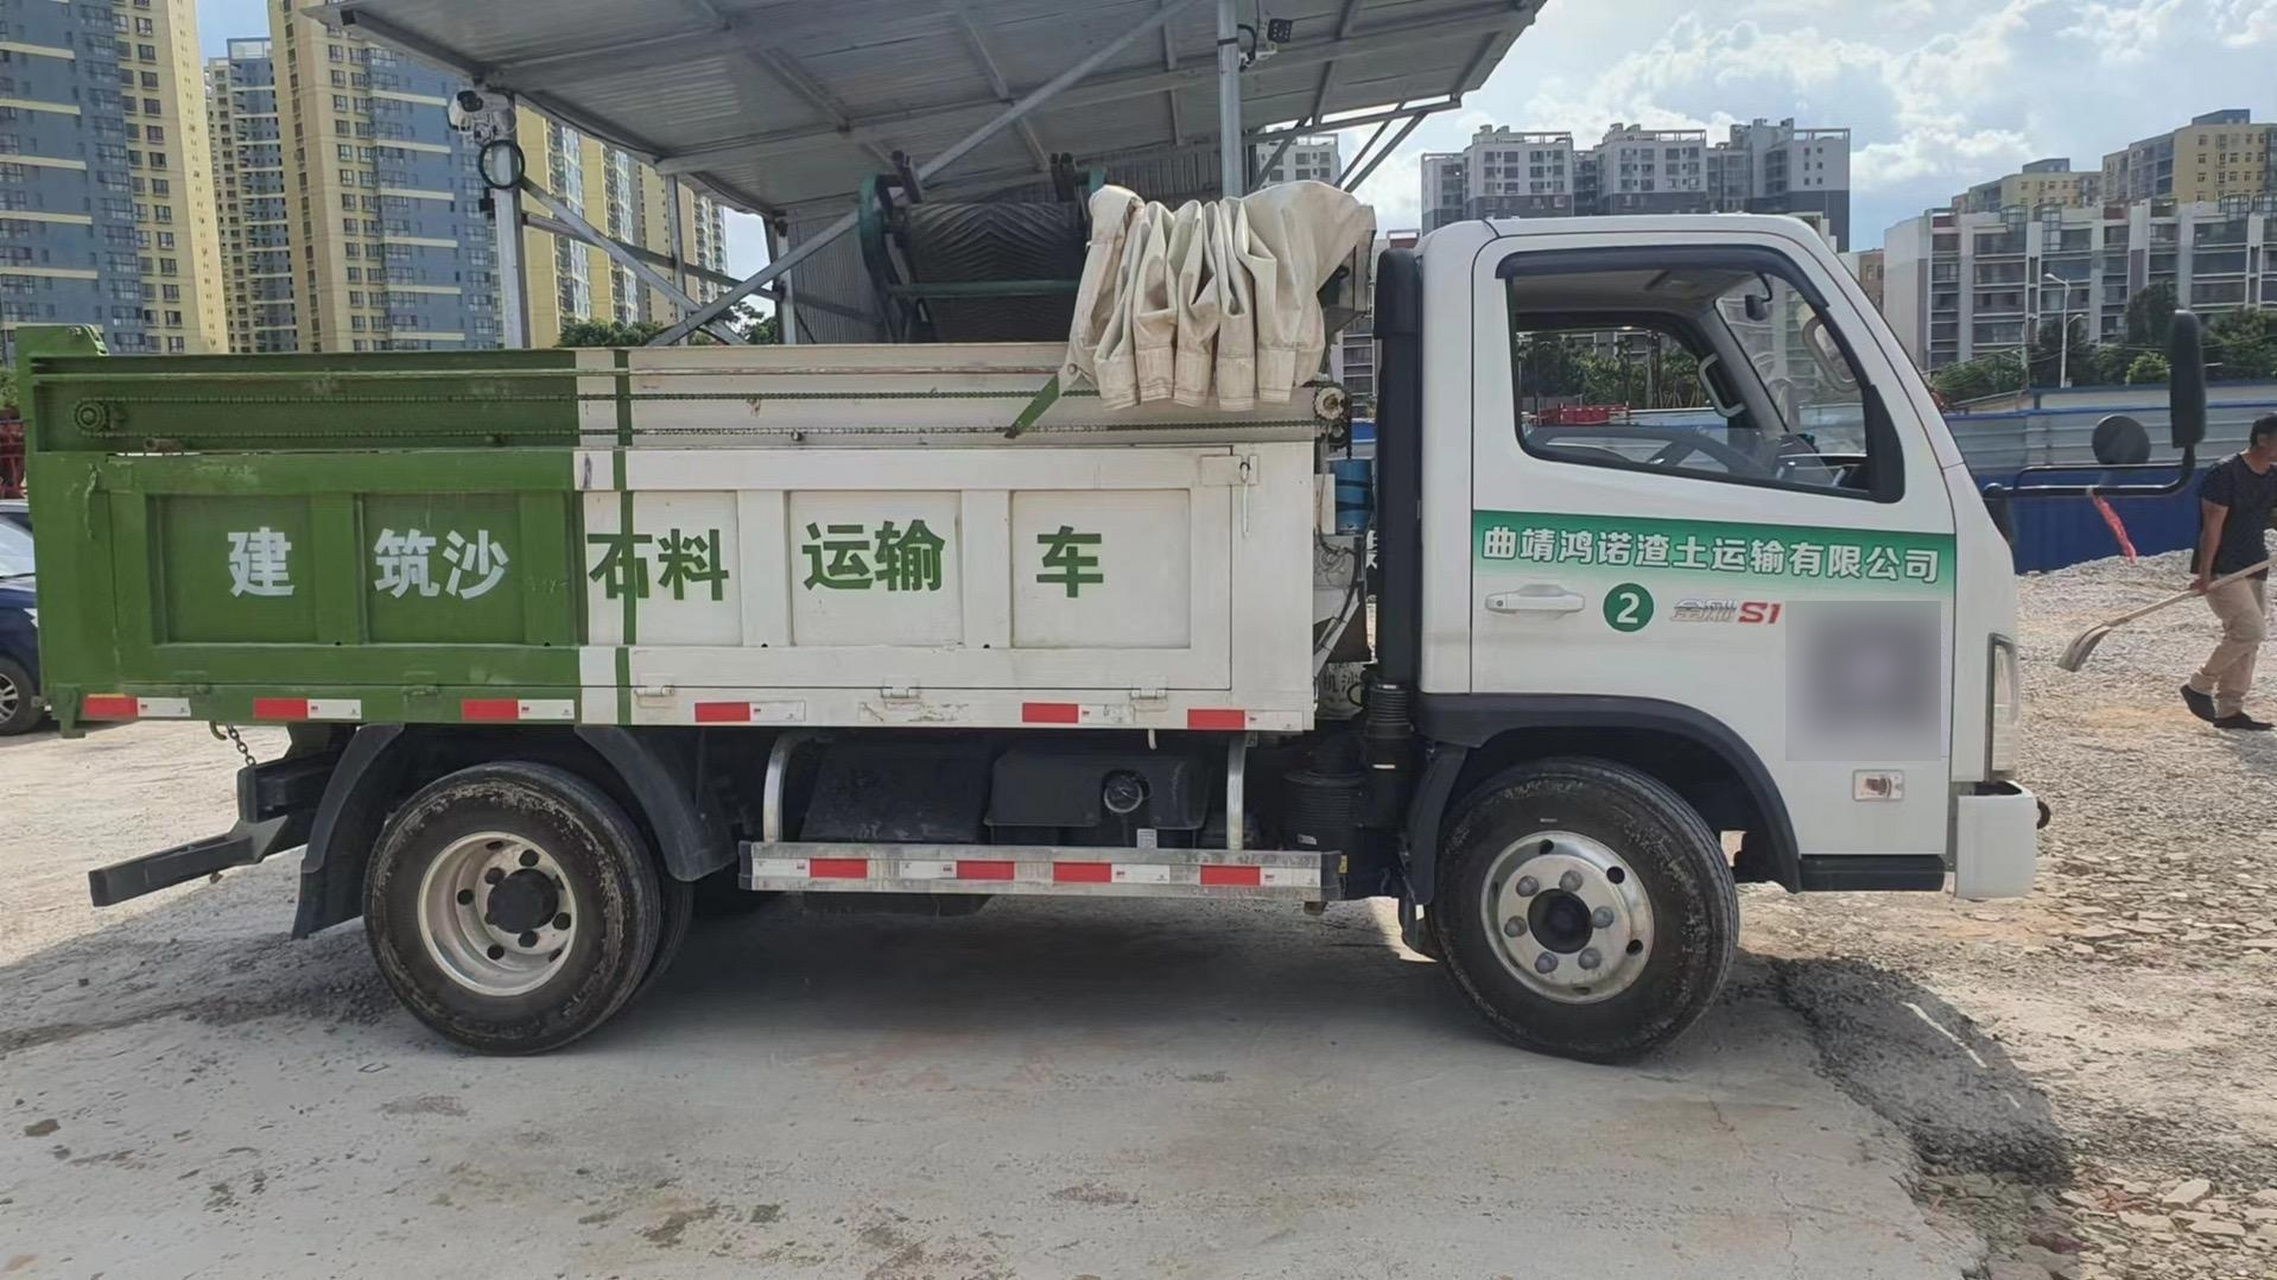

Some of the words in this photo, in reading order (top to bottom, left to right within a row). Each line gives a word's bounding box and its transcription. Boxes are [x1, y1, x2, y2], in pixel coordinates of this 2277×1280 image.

[227, 528, 295, 598] 建
[373, 529, 510, 600] 筑沙
[587, 529, 730, 601] 石料
[802, 519, 945, 593] 运输
[1036, 526, 1105, 598] 车
[1482, 526, 1940, 583] 曲靖鸿诺渣土运输有限公司
[1616, 592, 1641, 624] 2
